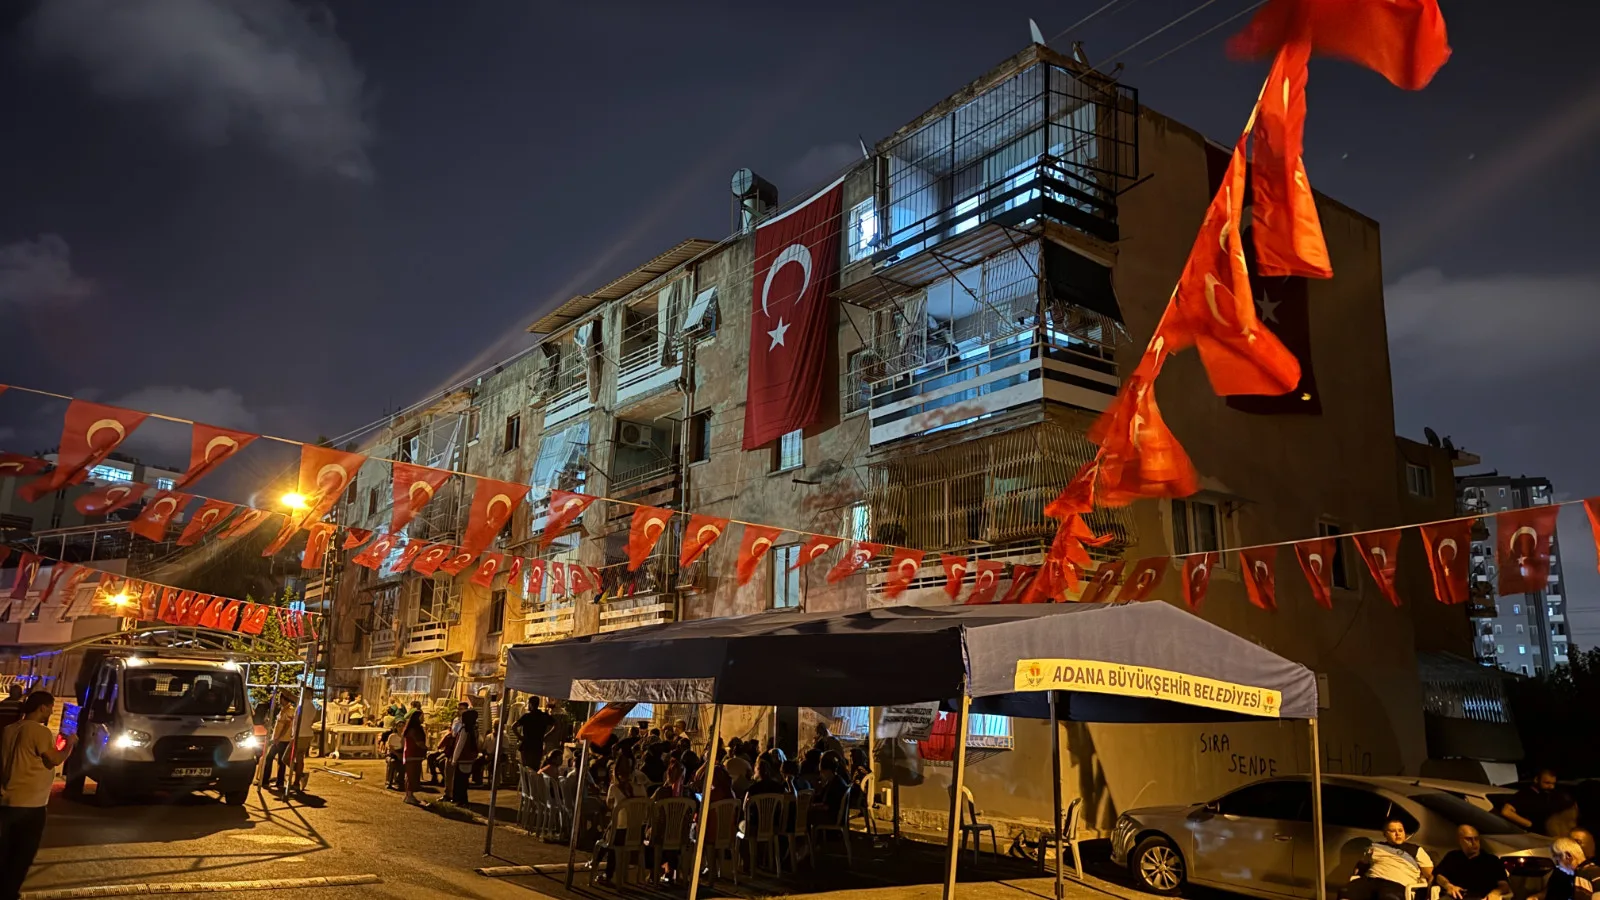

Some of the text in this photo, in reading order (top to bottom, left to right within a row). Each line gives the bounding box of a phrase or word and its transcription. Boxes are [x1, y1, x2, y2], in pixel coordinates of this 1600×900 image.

[1053, 666, 1261, 709] ADANA BÜYÜKŞEHİR BELEDİYESİ
[1200, 733, 1230, 753] SIRA
[1228, 754, 1277, 776] SENDE
